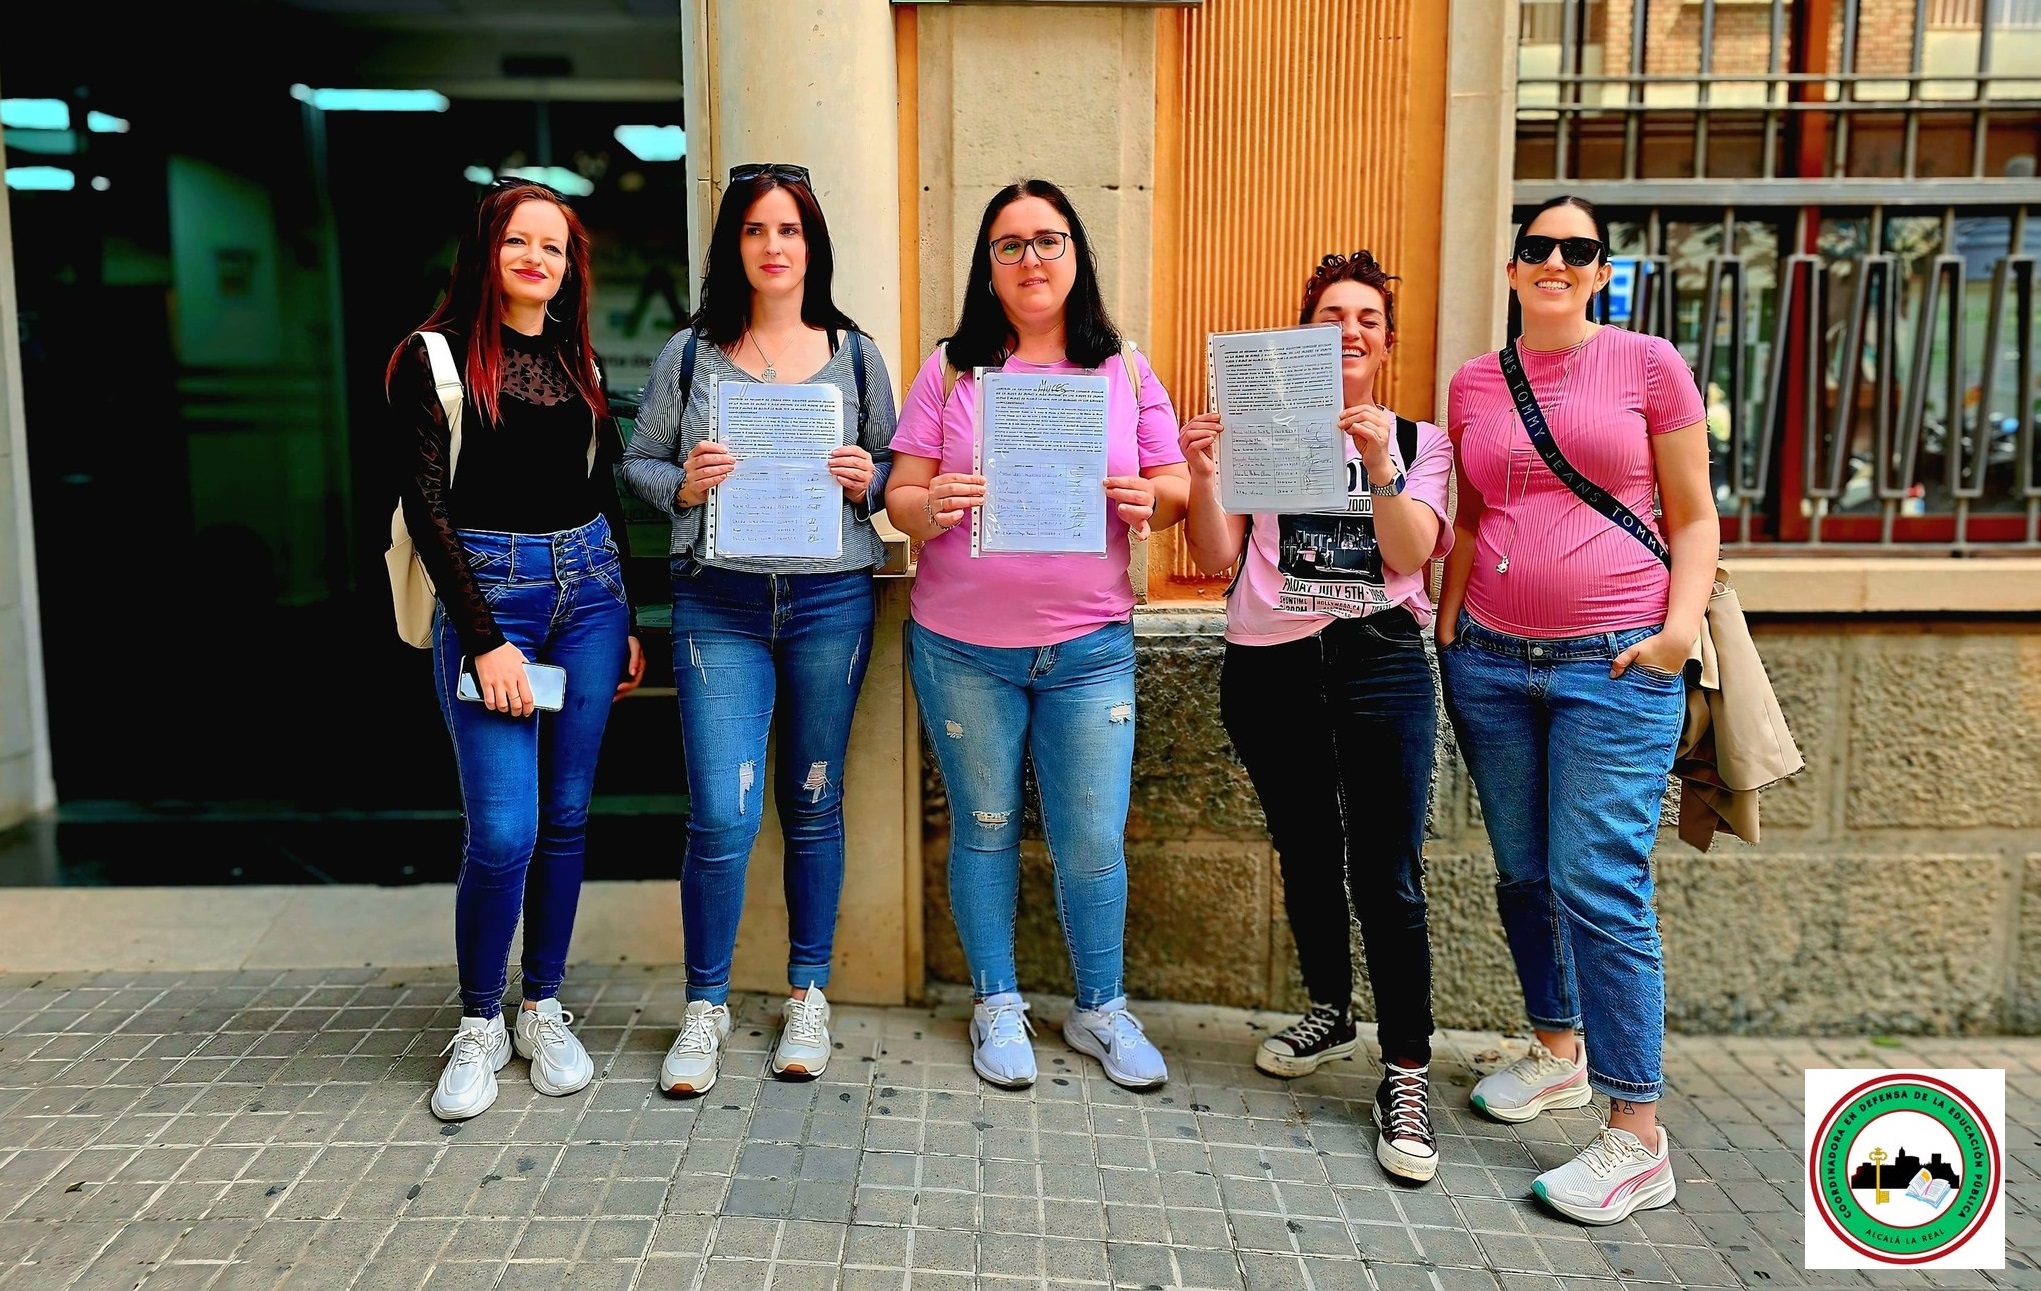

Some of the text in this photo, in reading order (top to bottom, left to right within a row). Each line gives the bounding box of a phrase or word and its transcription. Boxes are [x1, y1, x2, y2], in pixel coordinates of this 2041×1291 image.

[1513, 380, 1546, 437] TOMMY
[1545, 451, 1602, 503] JEANS
[1612, 505, 1665, 557] TOMMY
[1319, 585, 1342, 598] JULY
[1345, 586, 1365, 601] 5TH
